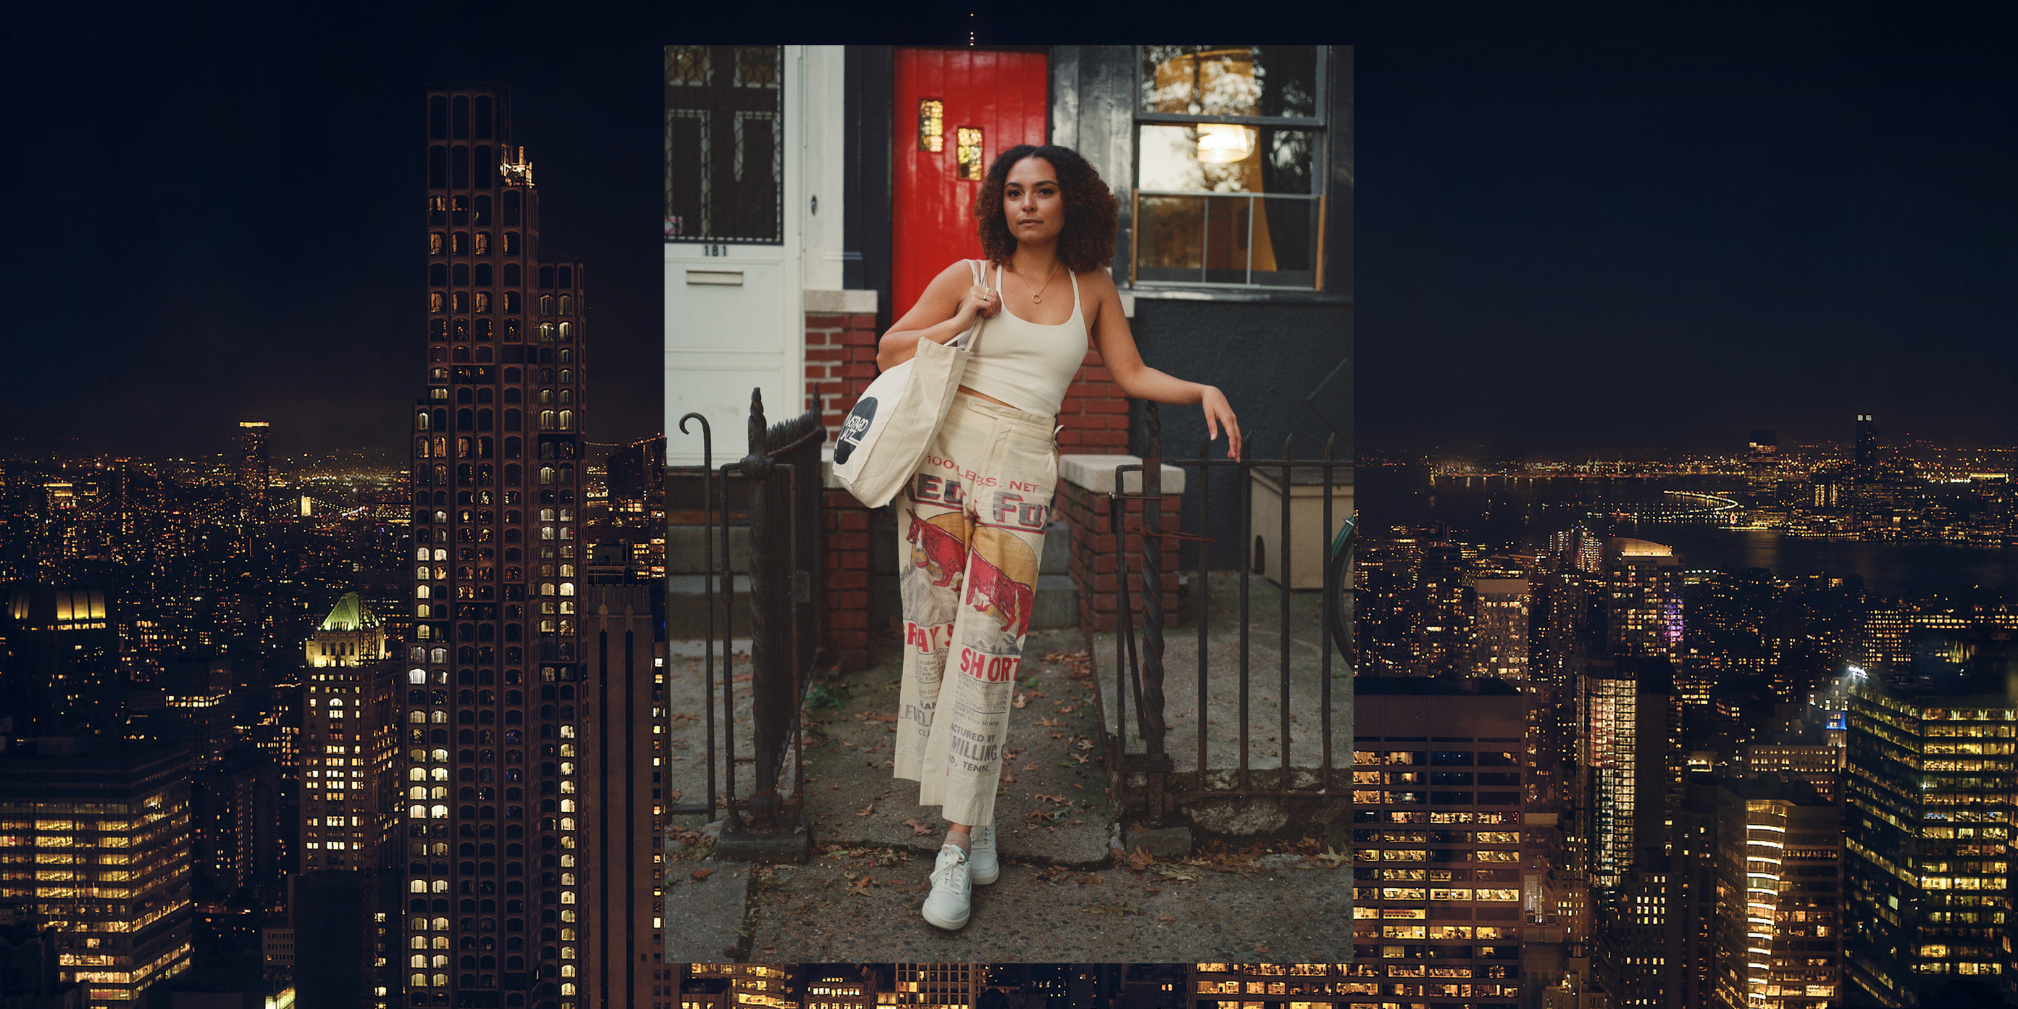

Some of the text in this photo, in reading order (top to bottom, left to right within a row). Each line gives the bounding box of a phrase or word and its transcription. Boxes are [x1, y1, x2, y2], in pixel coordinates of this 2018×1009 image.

[703, 245, 728, 257] 181
[926, 455, 954, 470] 100
[1009, 480, 1040, 493] NET
[902, 621, 942, 653] RAY
[951, 735, 998, 762] MILLING
[962, 760, 991, 773] TENN.
